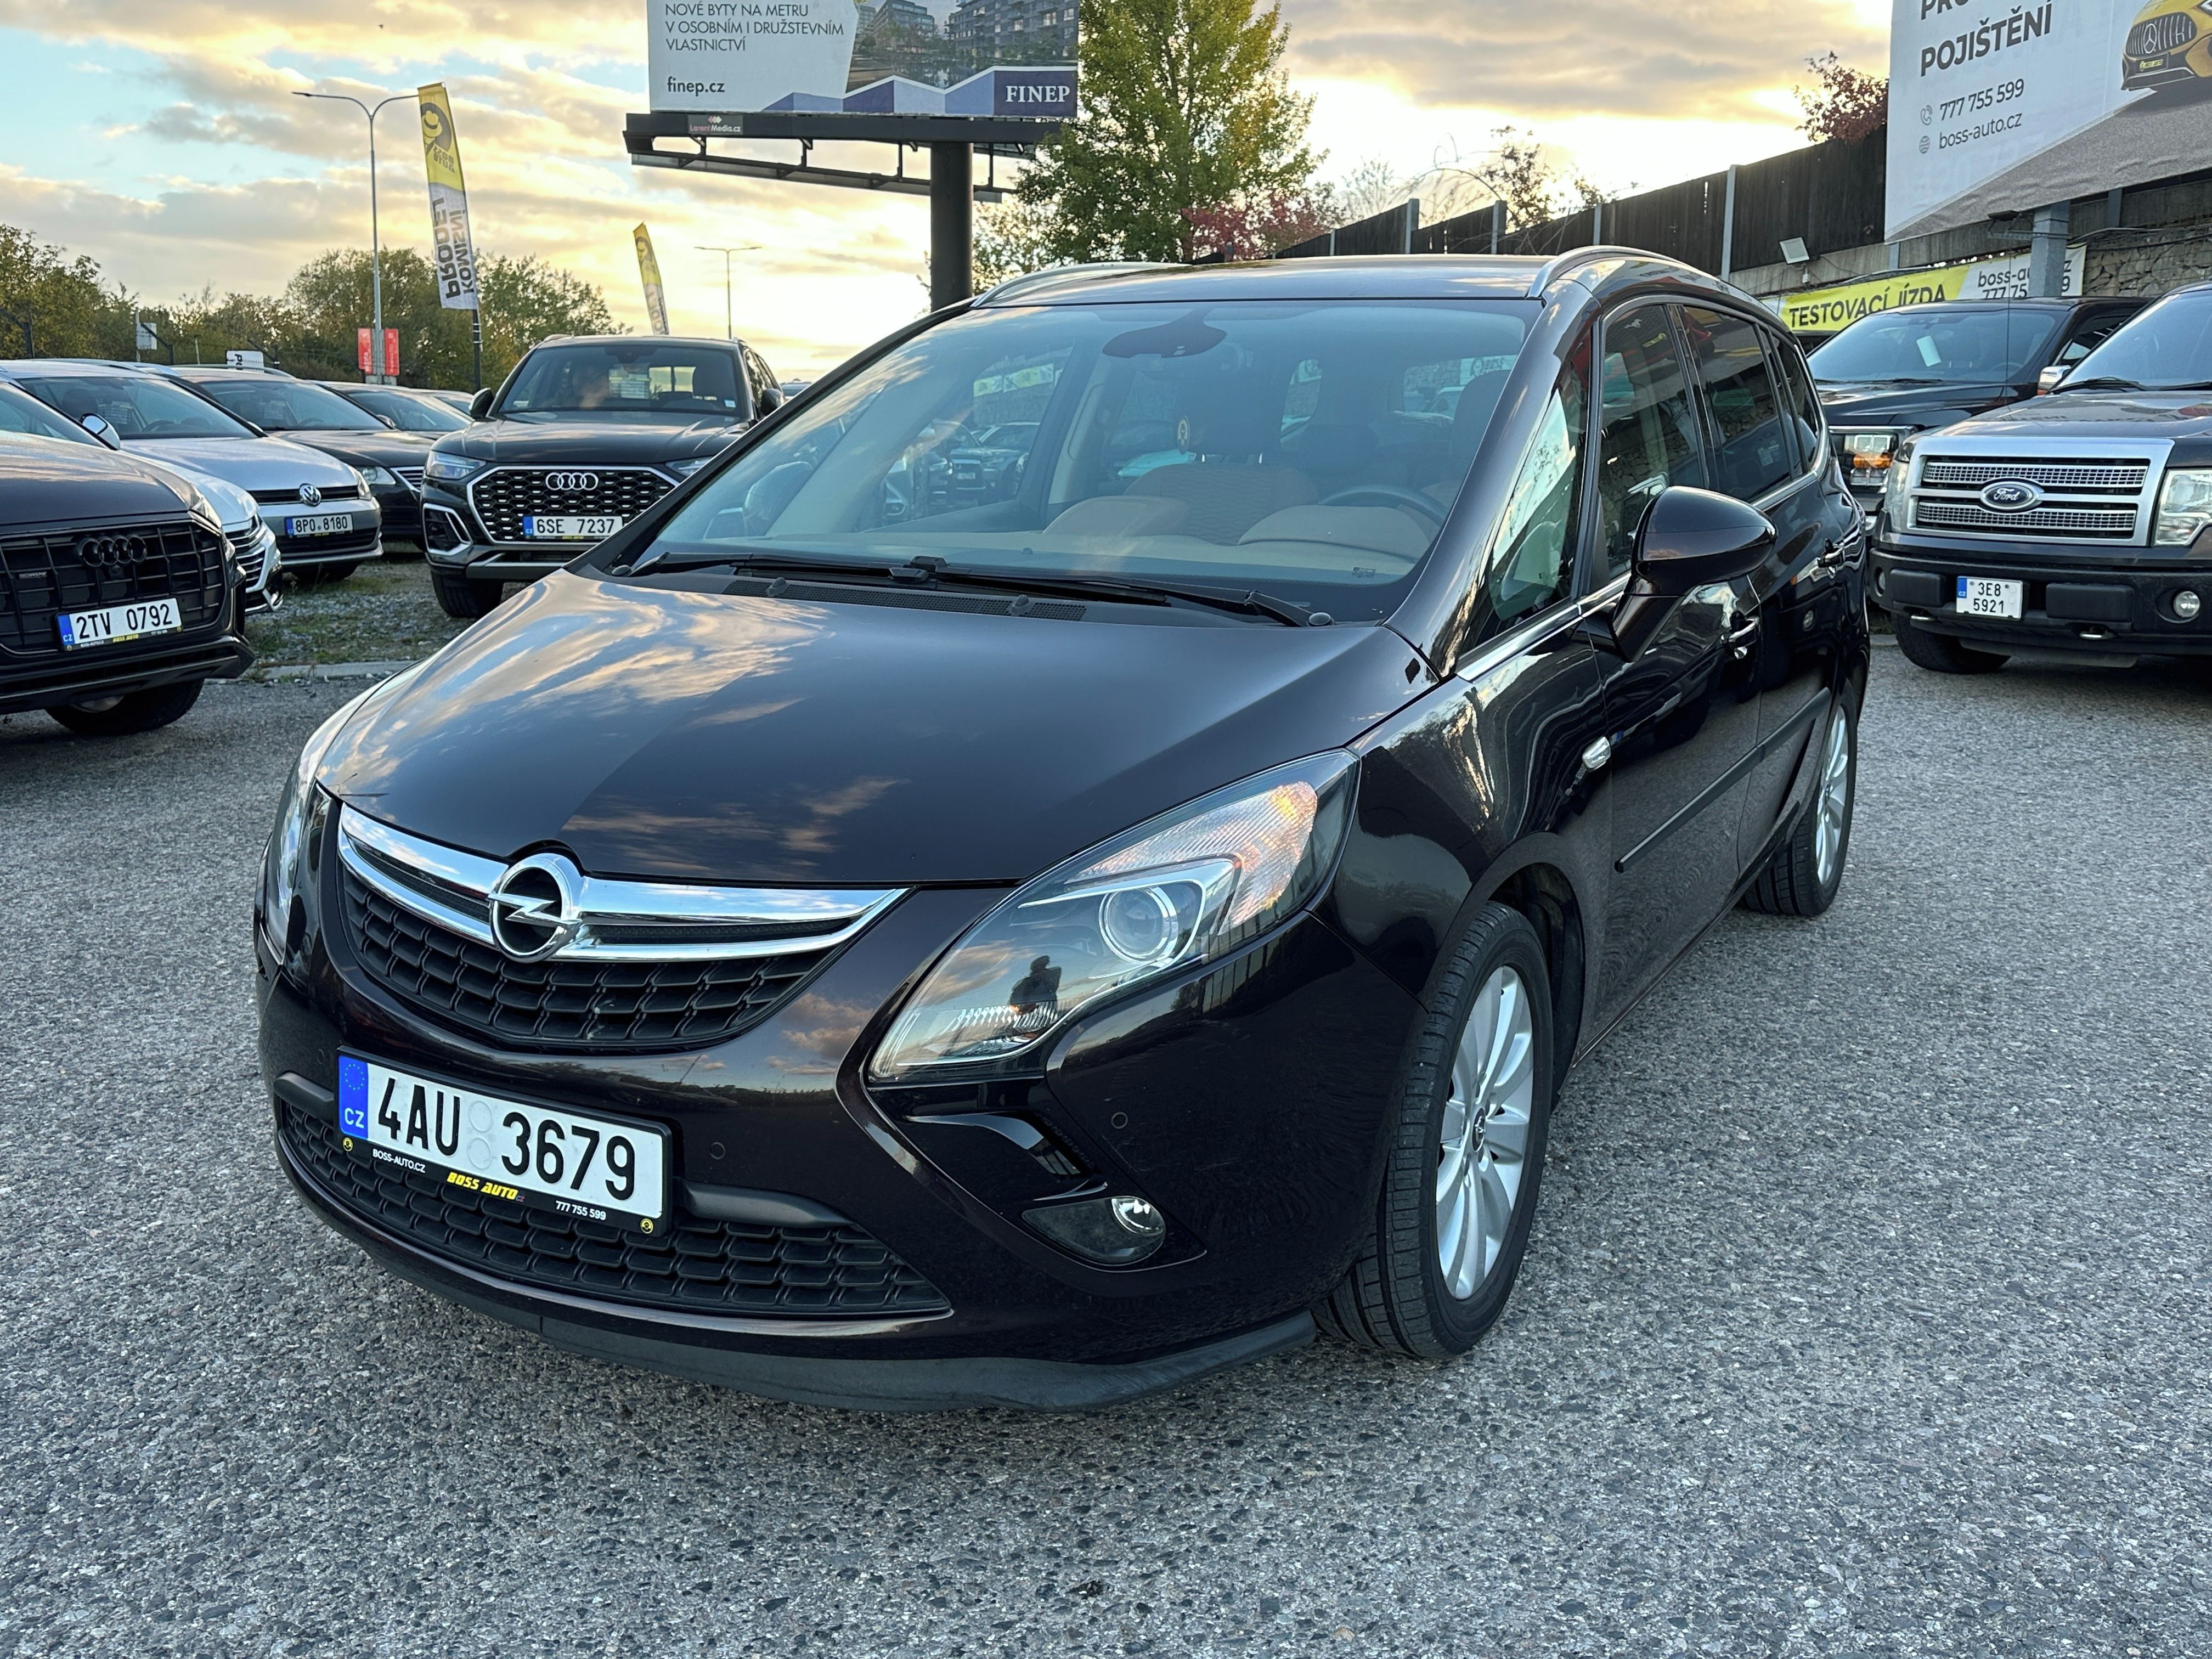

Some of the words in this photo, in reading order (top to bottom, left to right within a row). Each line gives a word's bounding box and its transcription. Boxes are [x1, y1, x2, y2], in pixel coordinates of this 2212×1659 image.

[665, 1, 704, 16] NOVÉ
[707, 4, 738, 16] BYTY
[741, 4, 762, 17] NA
[765, 4, 809, 17] METRU
[665, 21, 675, 33] V
[678, 18, 743, 34] OSOBNÍM
[746, 22, 749, 34] I
[754, 19, 844, 35] DRUŽSTEVNÍM
[665, 36, 747, 51] VLASTNICTVÍ
[1920, 0, 2052, 77] POJIŠTĚNÍ
[668, 76, 725, 97] finep.cz
[1005, 85, 1071, 103] FINEP
[1940, 97, 1965, 121] 777
[1968, 87, 1994, 112] 755
[1996, 78, 2024, 103] 599
[1939, 112, 2023, 150] boss-auto.cz
[1789, 286, 1890, 328] TESTOVACÍ
[1994, 488, 2021, 500] Ford
[323, 516, 347, 530] 8180
[537, 519, 565, 533] 6SE
[577, 519, 614, 533] 7237
[1978, 582, 2001, 596] 3E8
[1973, 598, 2004, 613] 5921
[76, 612, 111, 639] 2TV
[126, 603, 172, 631] 0792
[63, 634, 73, 642] CZ
[344, 1107, 364, 1128] CZ
[378, 1077, 460, 1156] 4AU
[501, 1111, 635, 1201] 3679
[373, 1148, 426, 1173] BOSS-AUTO.CZ
[447, 1171, 480, 1190] BOSS
[555, 1200, 571, 1212] 777
[571, 1204, 588, 1216] 755
[589, 1209, 607, 1221] 599
